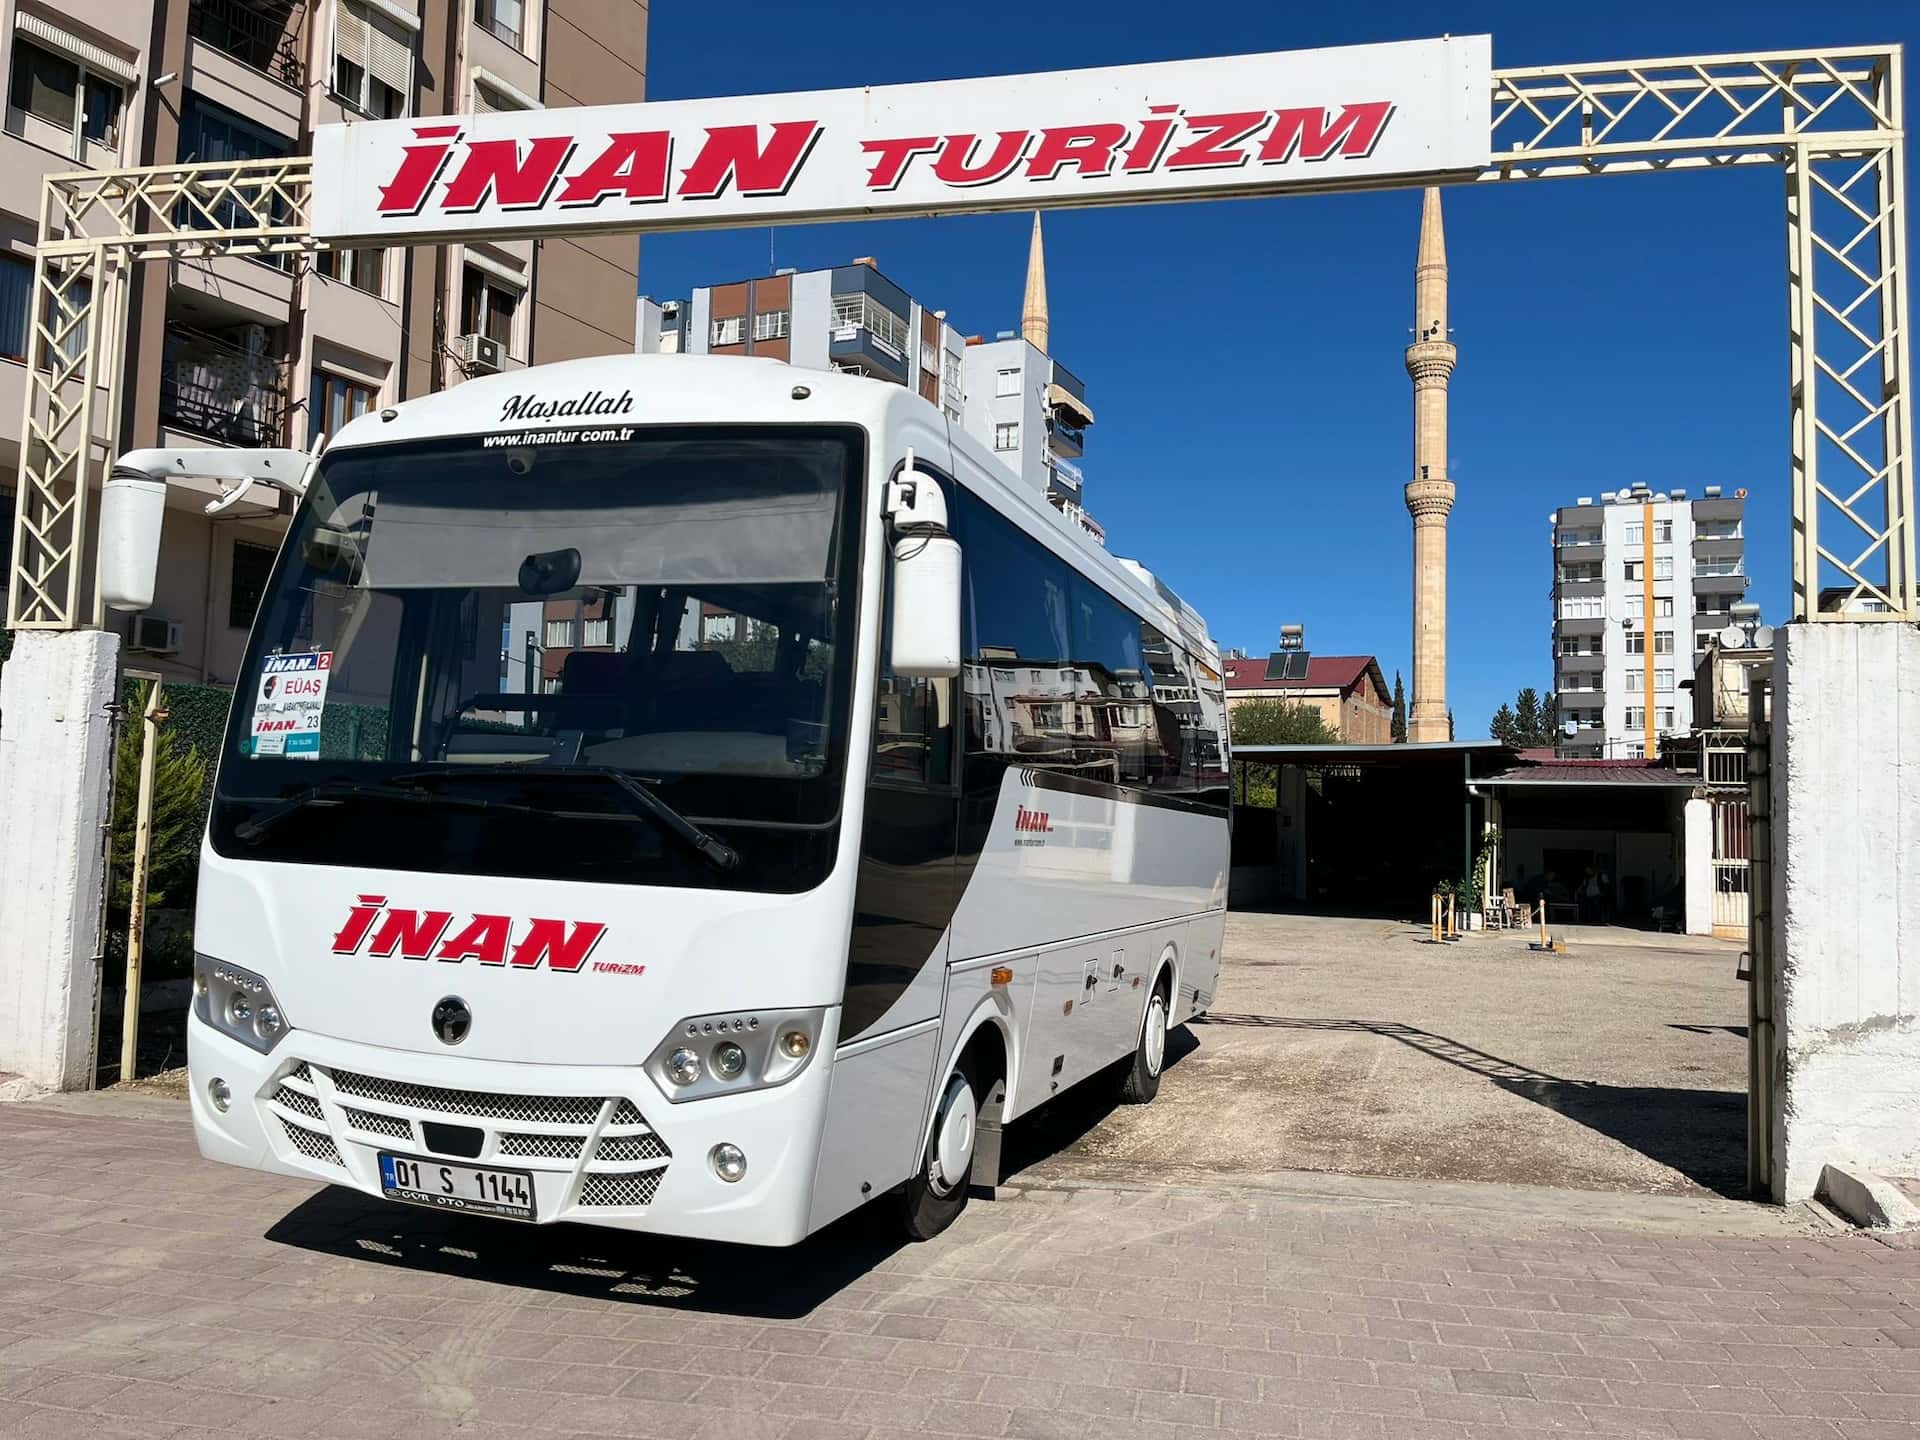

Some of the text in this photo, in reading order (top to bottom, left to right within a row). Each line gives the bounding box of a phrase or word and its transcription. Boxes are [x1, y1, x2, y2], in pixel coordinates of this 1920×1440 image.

[377, 101, 1397, 217] İNAN TURİZM
[500, 389, 635, 423] Maşallah
[320, 655, 329, 668] 2
[285, 677, 321, 696] EÜAŞ
[307, 715, 319, 728] 23
[1015, 804, 1049, 832] İNAN
[331, 894, 608, 974] İNAN
[396, 1160, 529, 1205] 01 S 1144
